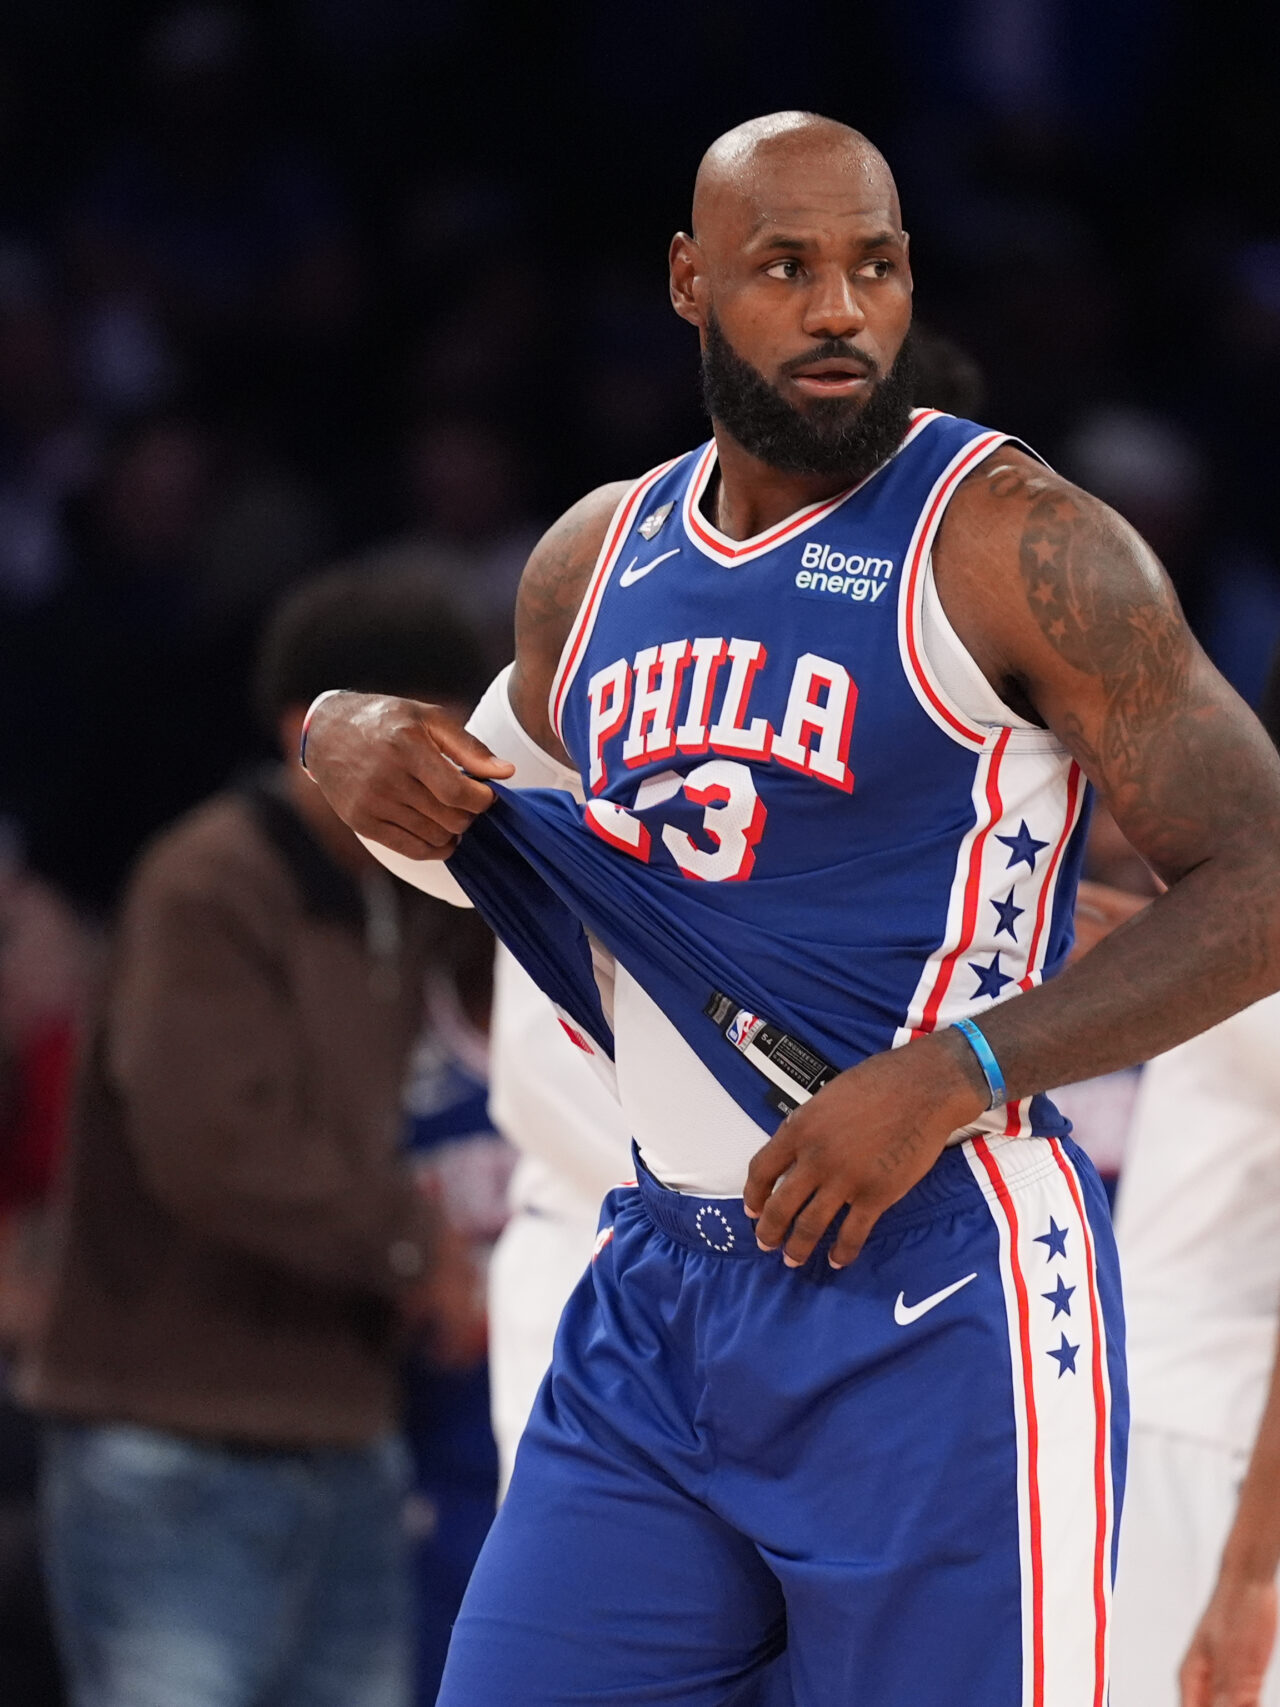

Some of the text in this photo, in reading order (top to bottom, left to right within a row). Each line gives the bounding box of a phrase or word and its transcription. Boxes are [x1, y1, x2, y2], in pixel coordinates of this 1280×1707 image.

[801, 543, 893, 579] Bloom
[795, 570, 888, 602] energy
[587, 637, 859, 796] PHILA
